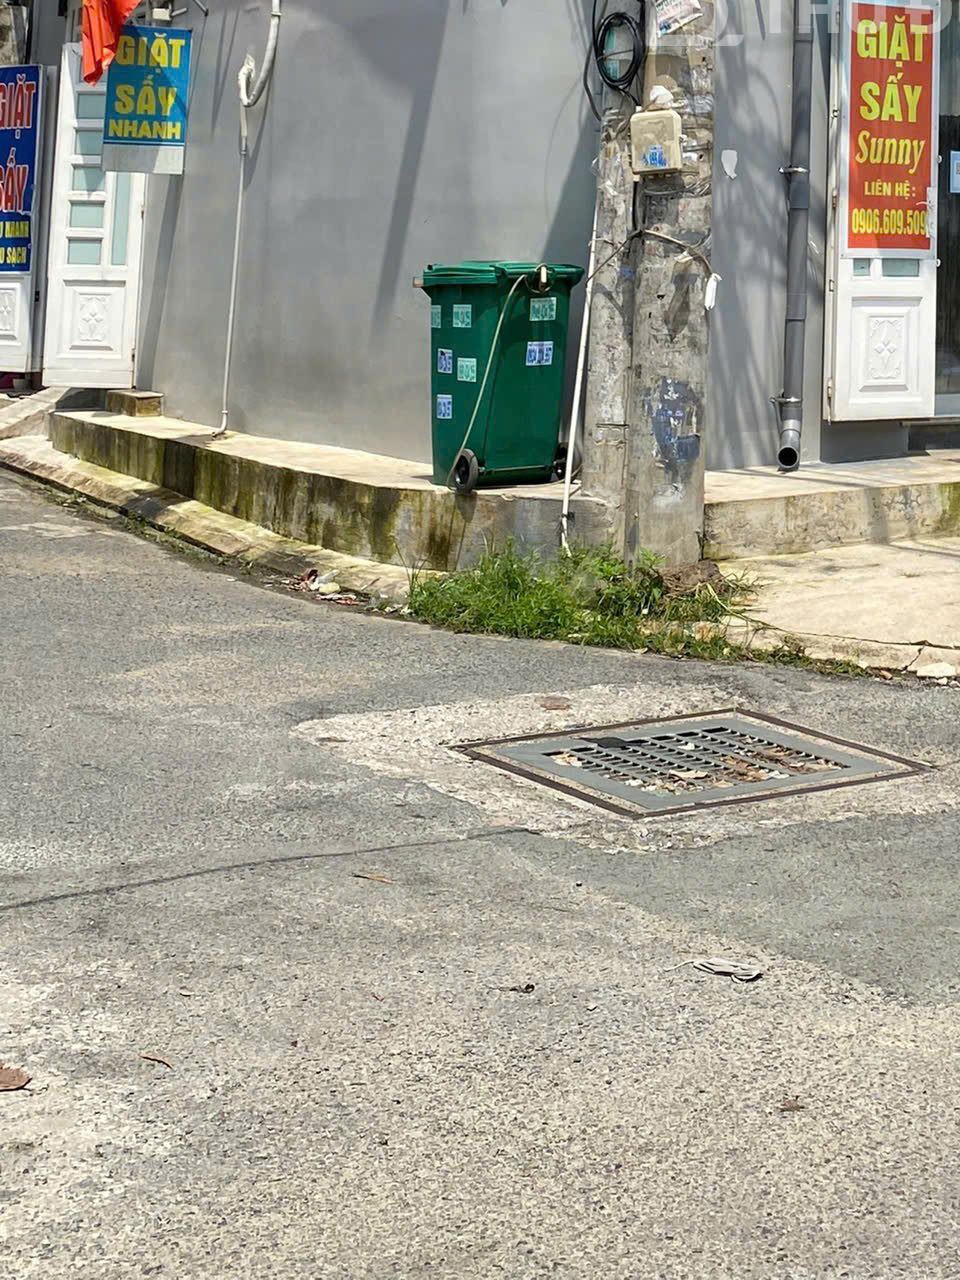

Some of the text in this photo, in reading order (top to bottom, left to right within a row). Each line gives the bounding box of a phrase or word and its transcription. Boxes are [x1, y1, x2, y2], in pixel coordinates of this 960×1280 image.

[115, 32, 186, 73] GIẶT
[856, 15, 929, 68] GIẶT
[114, 75, 178, 117] SẤY
[859, 72, 923, 123] SẤY
[108, 119, 182, 140] NHANH
[855, 130, 925, 174] Sunny
[864, 179, 916, 200] LIÊN HỆ:
[852, 208, 927, 235] 0906.609.509
[6, 246, 27, 268] SẠCH
